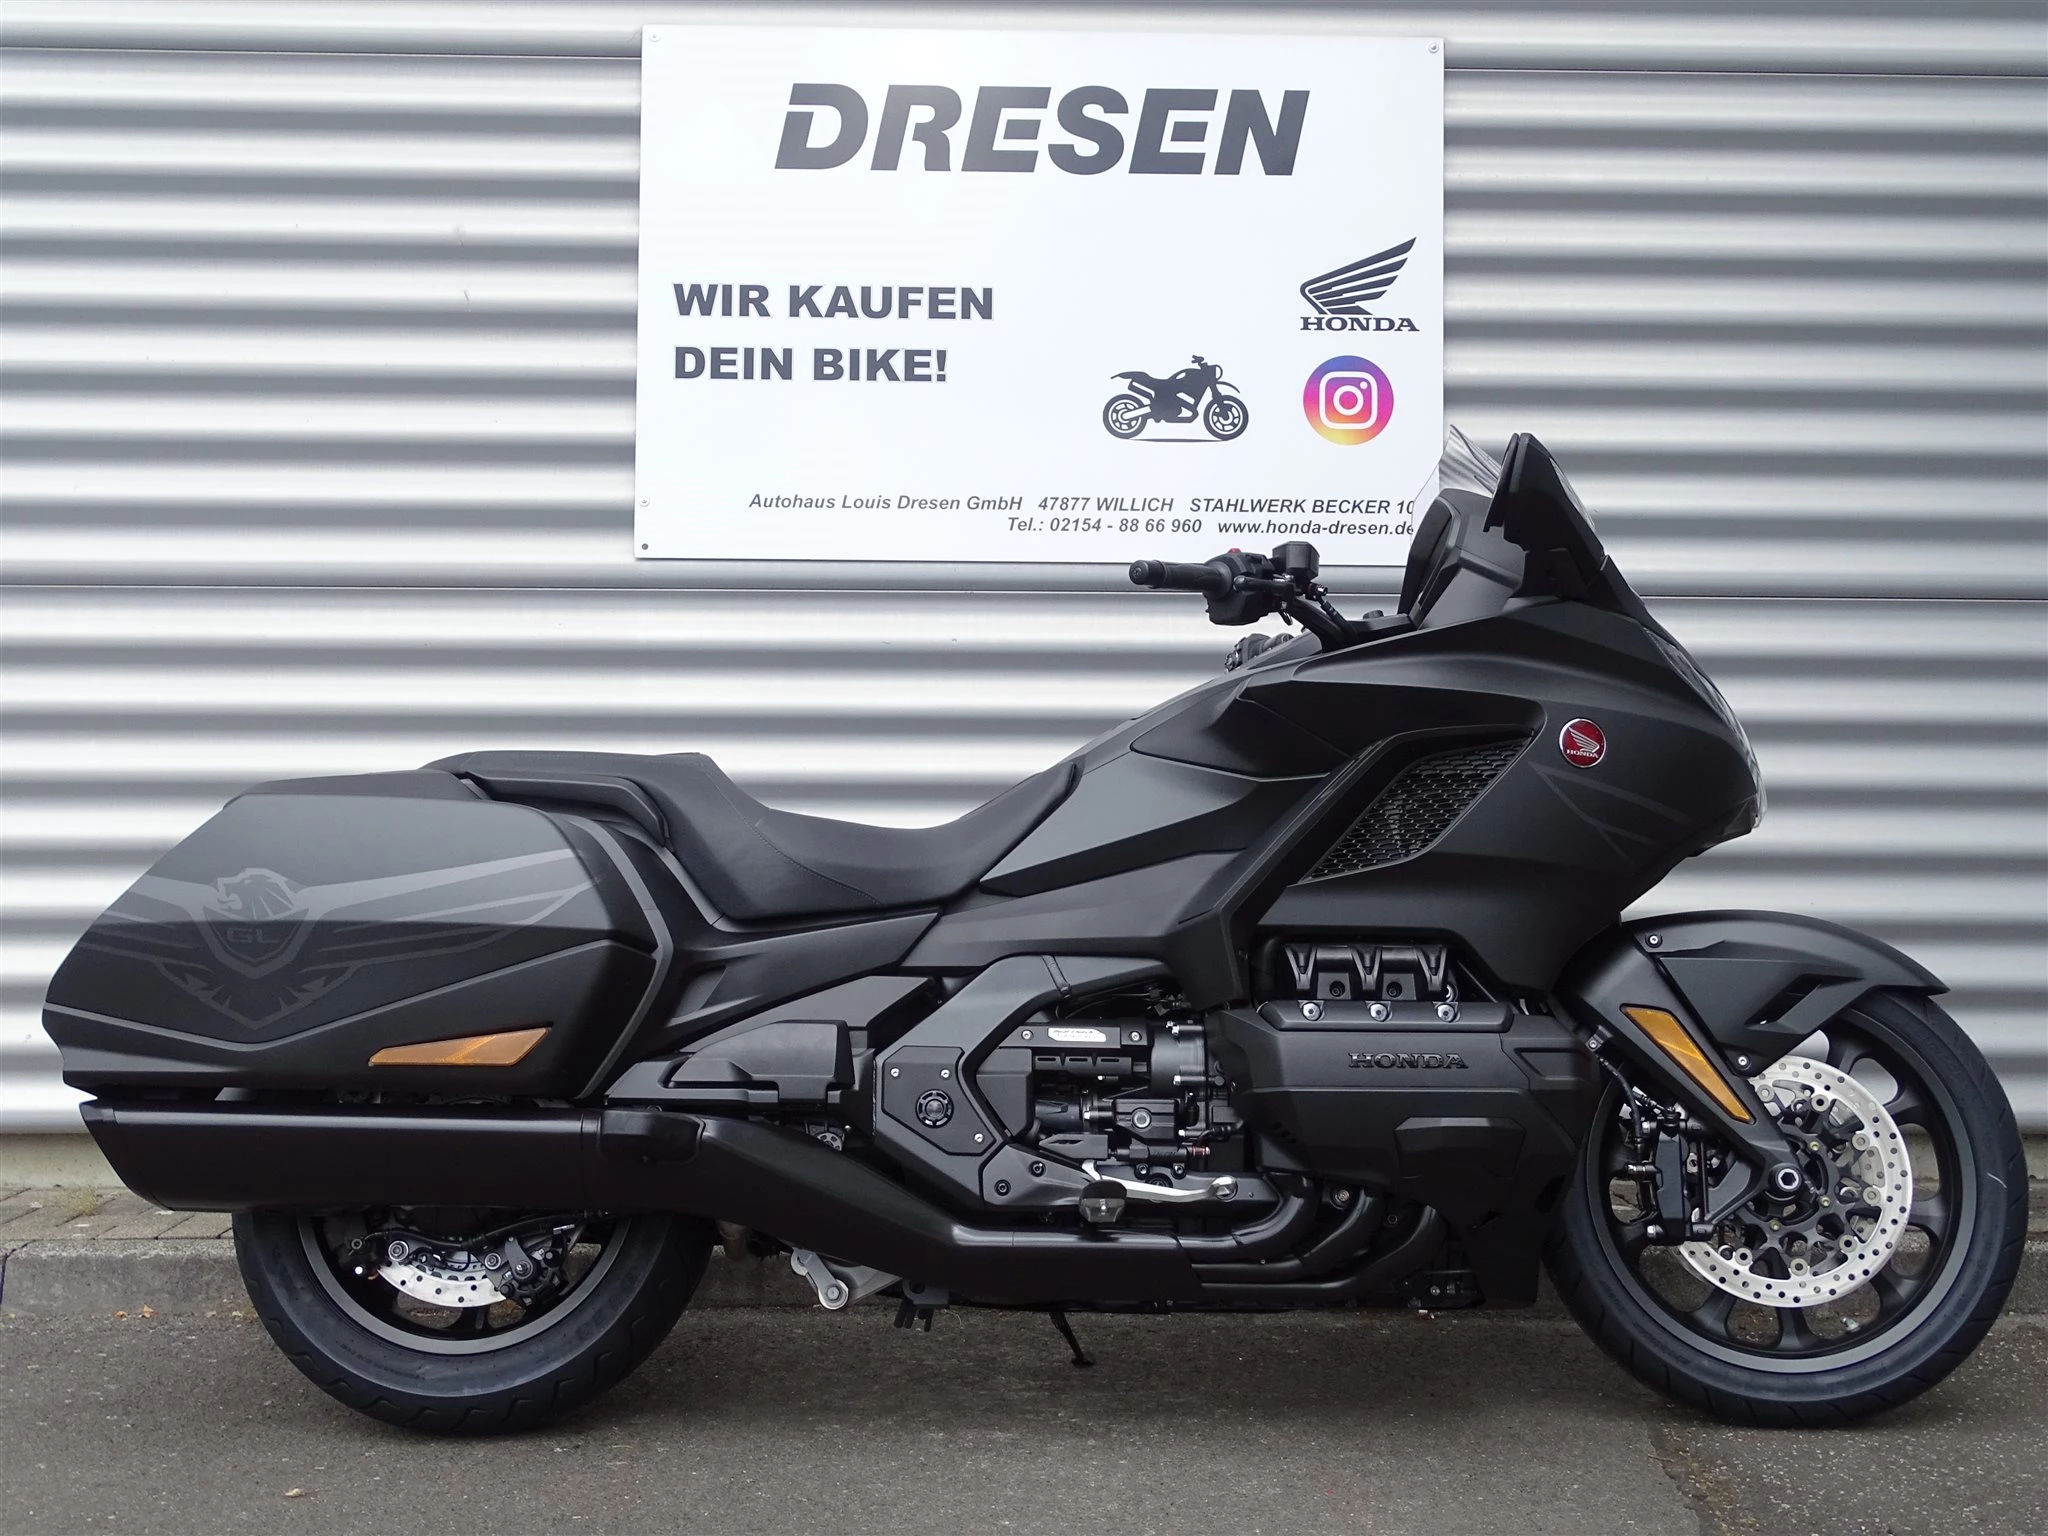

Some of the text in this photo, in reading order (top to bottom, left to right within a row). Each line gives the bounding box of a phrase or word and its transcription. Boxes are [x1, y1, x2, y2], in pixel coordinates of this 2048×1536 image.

[775, 84, 1309, 175] DRESEN
[674, 284, 992, 319] WIR KAUFEN
[1300, 316, 1419, 331] HONDA
[676, 347, 947, 382] DEIN BIKE!
[749, 494, 836, 509] Autohaus
[842, 495, 891, 509] Louis
[898, 496, 961, 510] Dresen
[967, 496, 1023, 511] GmbH
[1039, 497, 1091, 511] 47877
[1097, 497, 1174, 512] WILLICH
[1190, 498, 1307, 513] STAHLWERK
[1312, 500, 1391, 514] BECKER
[1009, 518, 1044, 532] Tel.:
[1050, 518, 1102, 532] 02154
[1119, 519, 1140, 533] 88
[1146, 519, 1166, 533] 66
[1172, 519, 1202, 533] 960
[1219, 520, 1414, 535] www.honda-dresen.de
[1566, 749, 1599, 759] HONDA
[1348, 1052, 1469, 1069] HONDA
